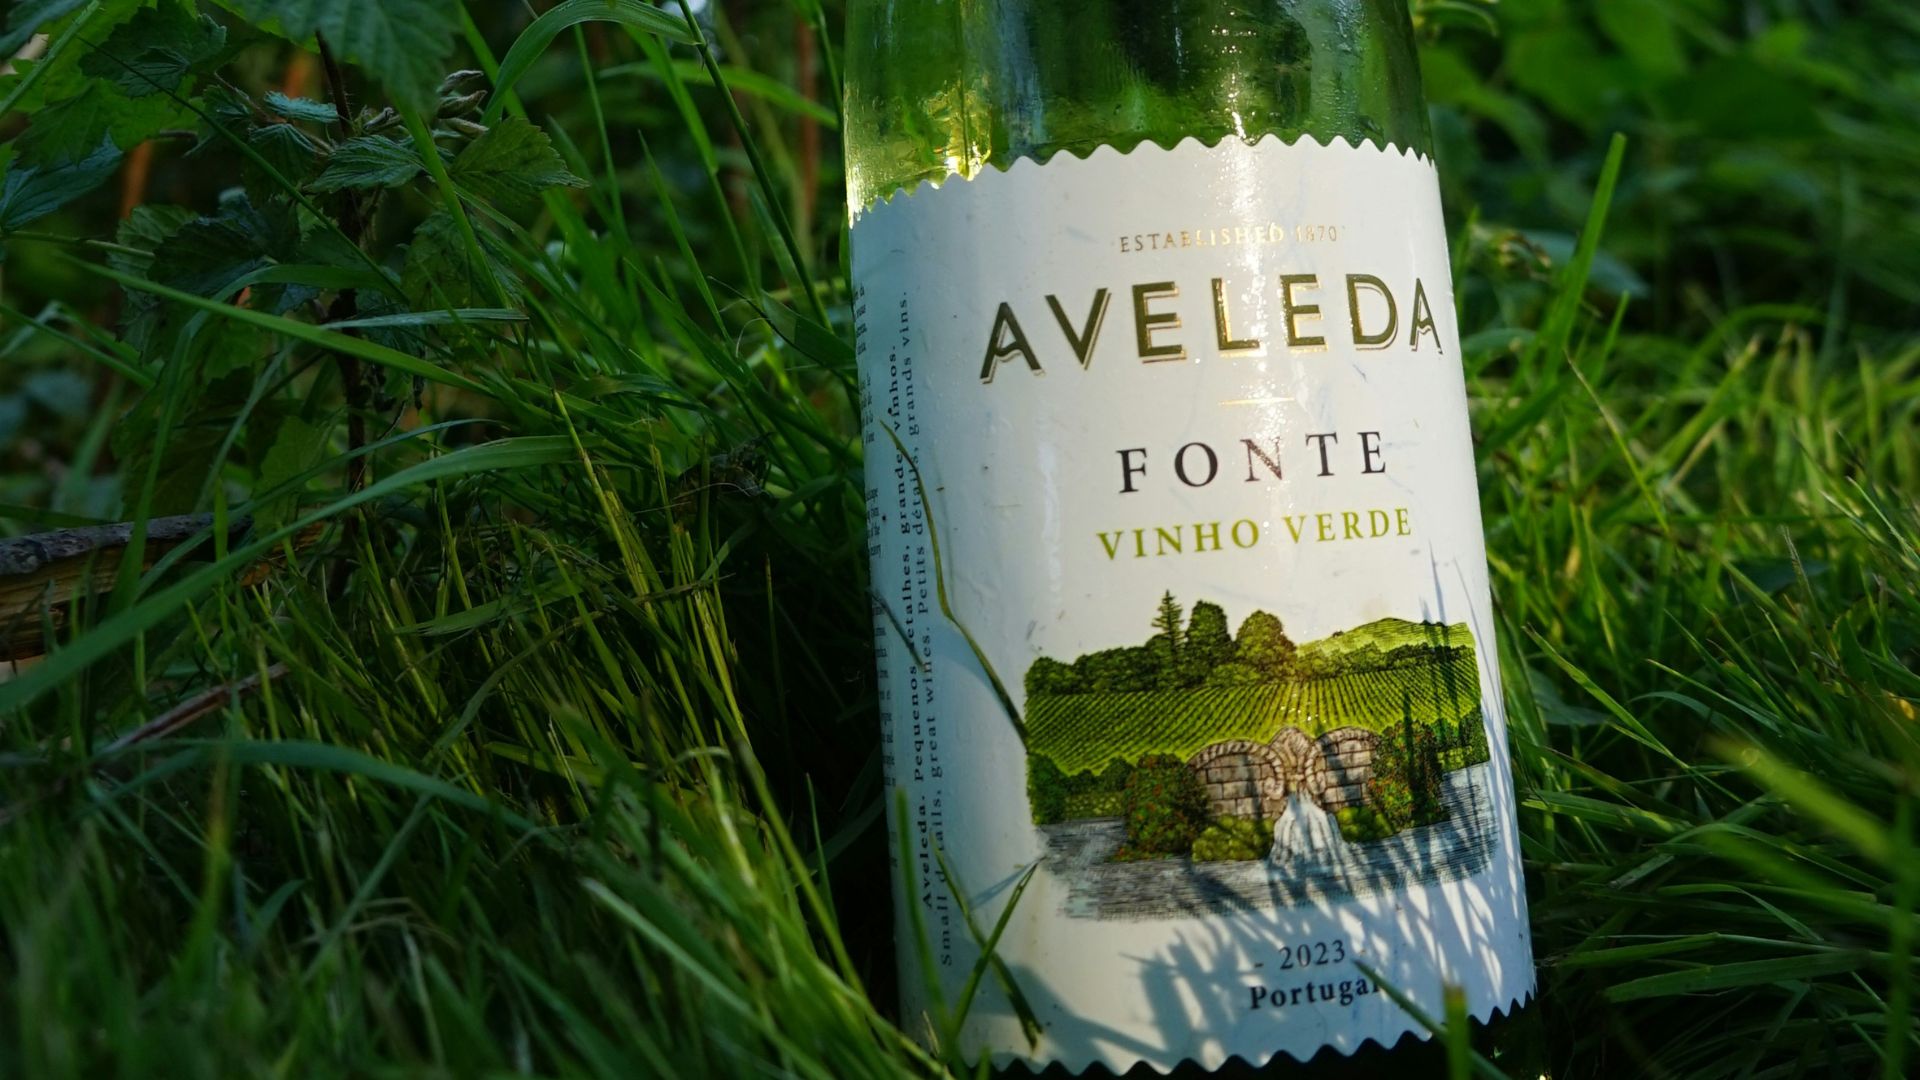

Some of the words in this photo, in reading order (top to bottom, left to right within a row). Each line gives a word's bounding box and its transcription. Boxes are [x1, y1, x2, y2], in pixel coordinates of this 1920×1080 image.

[1120, 225, 1284, 252] ESTABLISHED
[1296, 225, 1338, 242] 1870
[900, 292, 911, 347] vins.
[979, 273, 1444, 385] AVELEDA
[888, 346, 901, 431] vinhos.
[902, 357, 920, 436] grands
[894, 446, 911, 534] grande
[1116, 431, 1386, 493] FONTE
[1097, 519, 1259, 560] VINHO
[1282, 508, 1412, 543] VERDE
[916, 546, 929, 614] Petits
[922, 627, 934, 704] wines.
[910, 665, 925, 782] Pequenos
[926, 717, 943, 778] great
[917, 795, 932, 909] Aveleda.
[936, 895, 952, 967] Small
[1279, 939, 1346, 970] 2023
